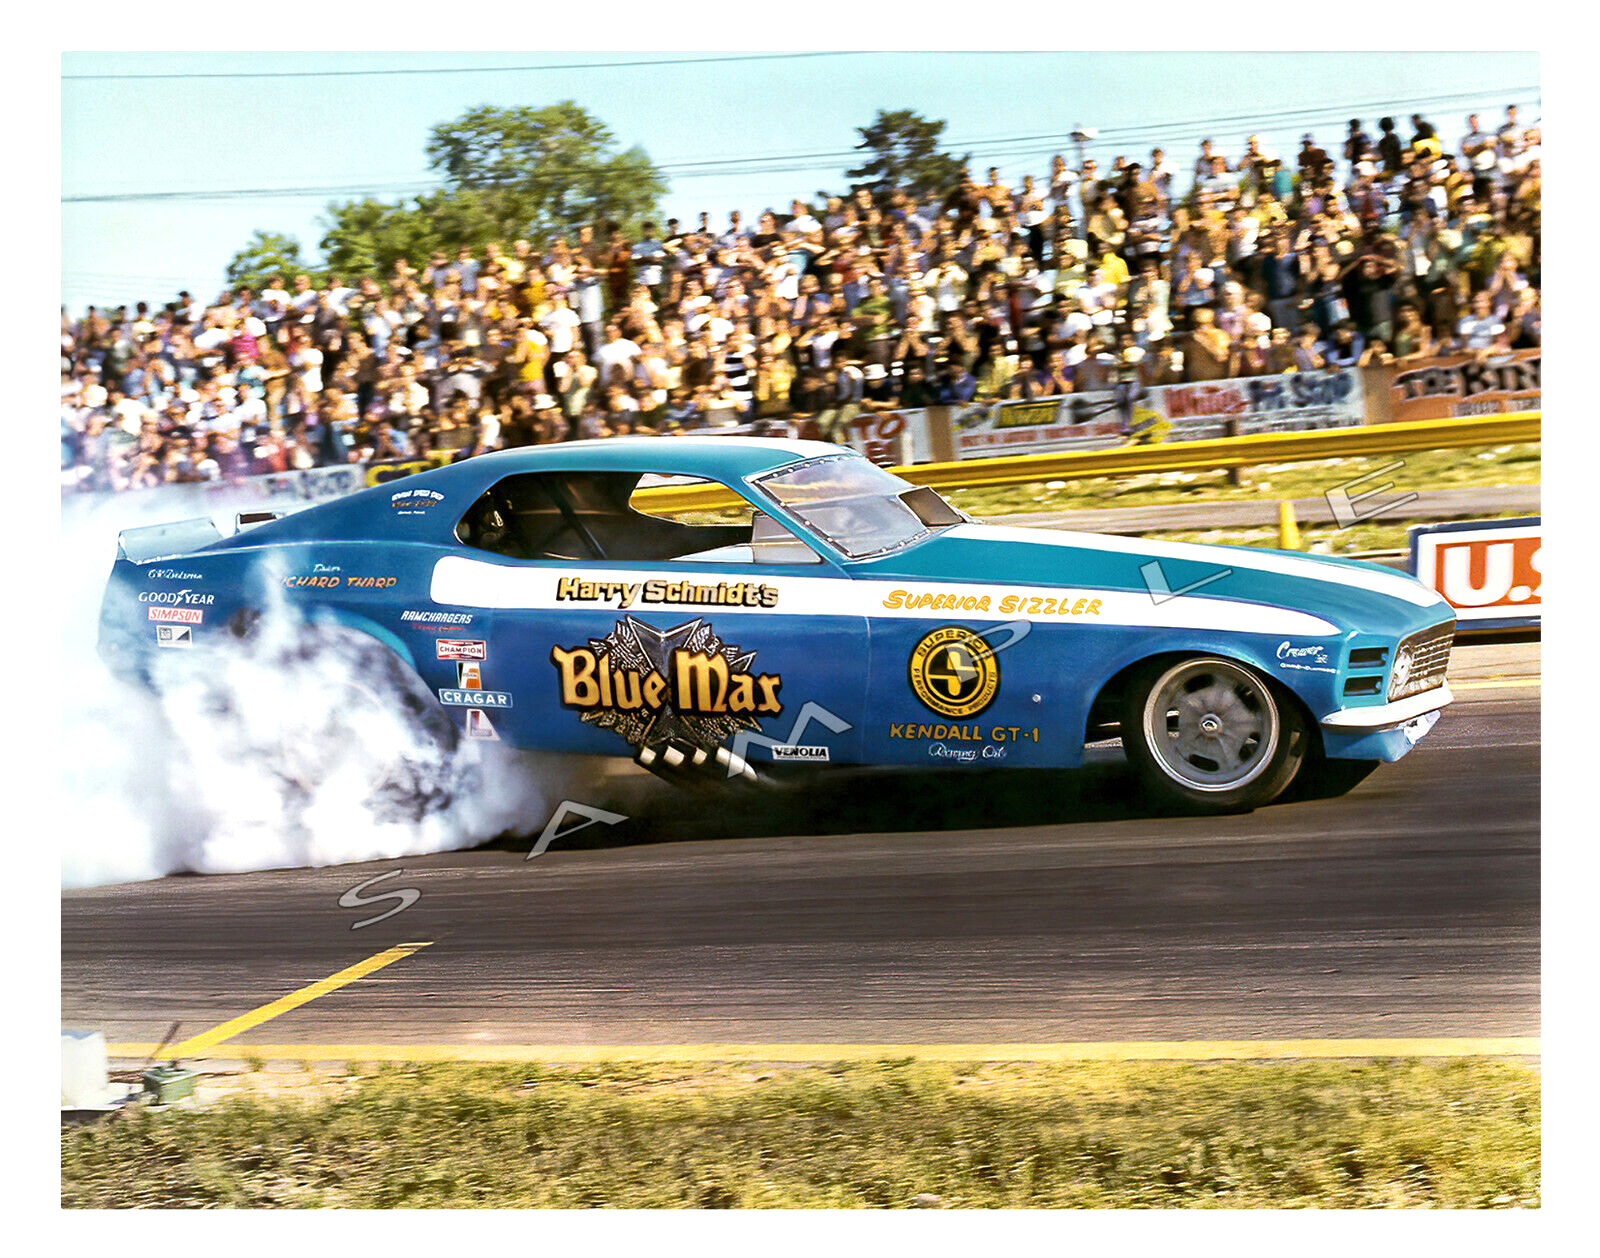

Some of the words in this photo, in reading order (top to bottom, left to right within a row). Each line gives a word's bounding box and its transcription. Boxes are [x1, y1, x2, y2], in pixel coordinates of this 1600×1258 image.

[1444, 542, 1541, 607] U.
[347, 577, 397, 588] THARP
[556, 577, 641, 608] Harry
[642, 579, 779, 607] Schmidt's
[883, 590, 991, 611] SUPERIOR
[999, 595, 1103, 615] SIZZLER
[150, 609, 201, 621] SIMPSON
[400, 610, 473, 624] RAMCHARGERS
[439, 646, 482, 654] CHAMPION
[553, 645, 667, 708] Blue
[675, 650, 782, 713] Max
[443, 691, 507, 705] CRAGAR
[890, 723, 983, 741] KENDALL
[991, 727, 1039, 742] GT-1
[775, 747, 826, 757] VENOLIA
